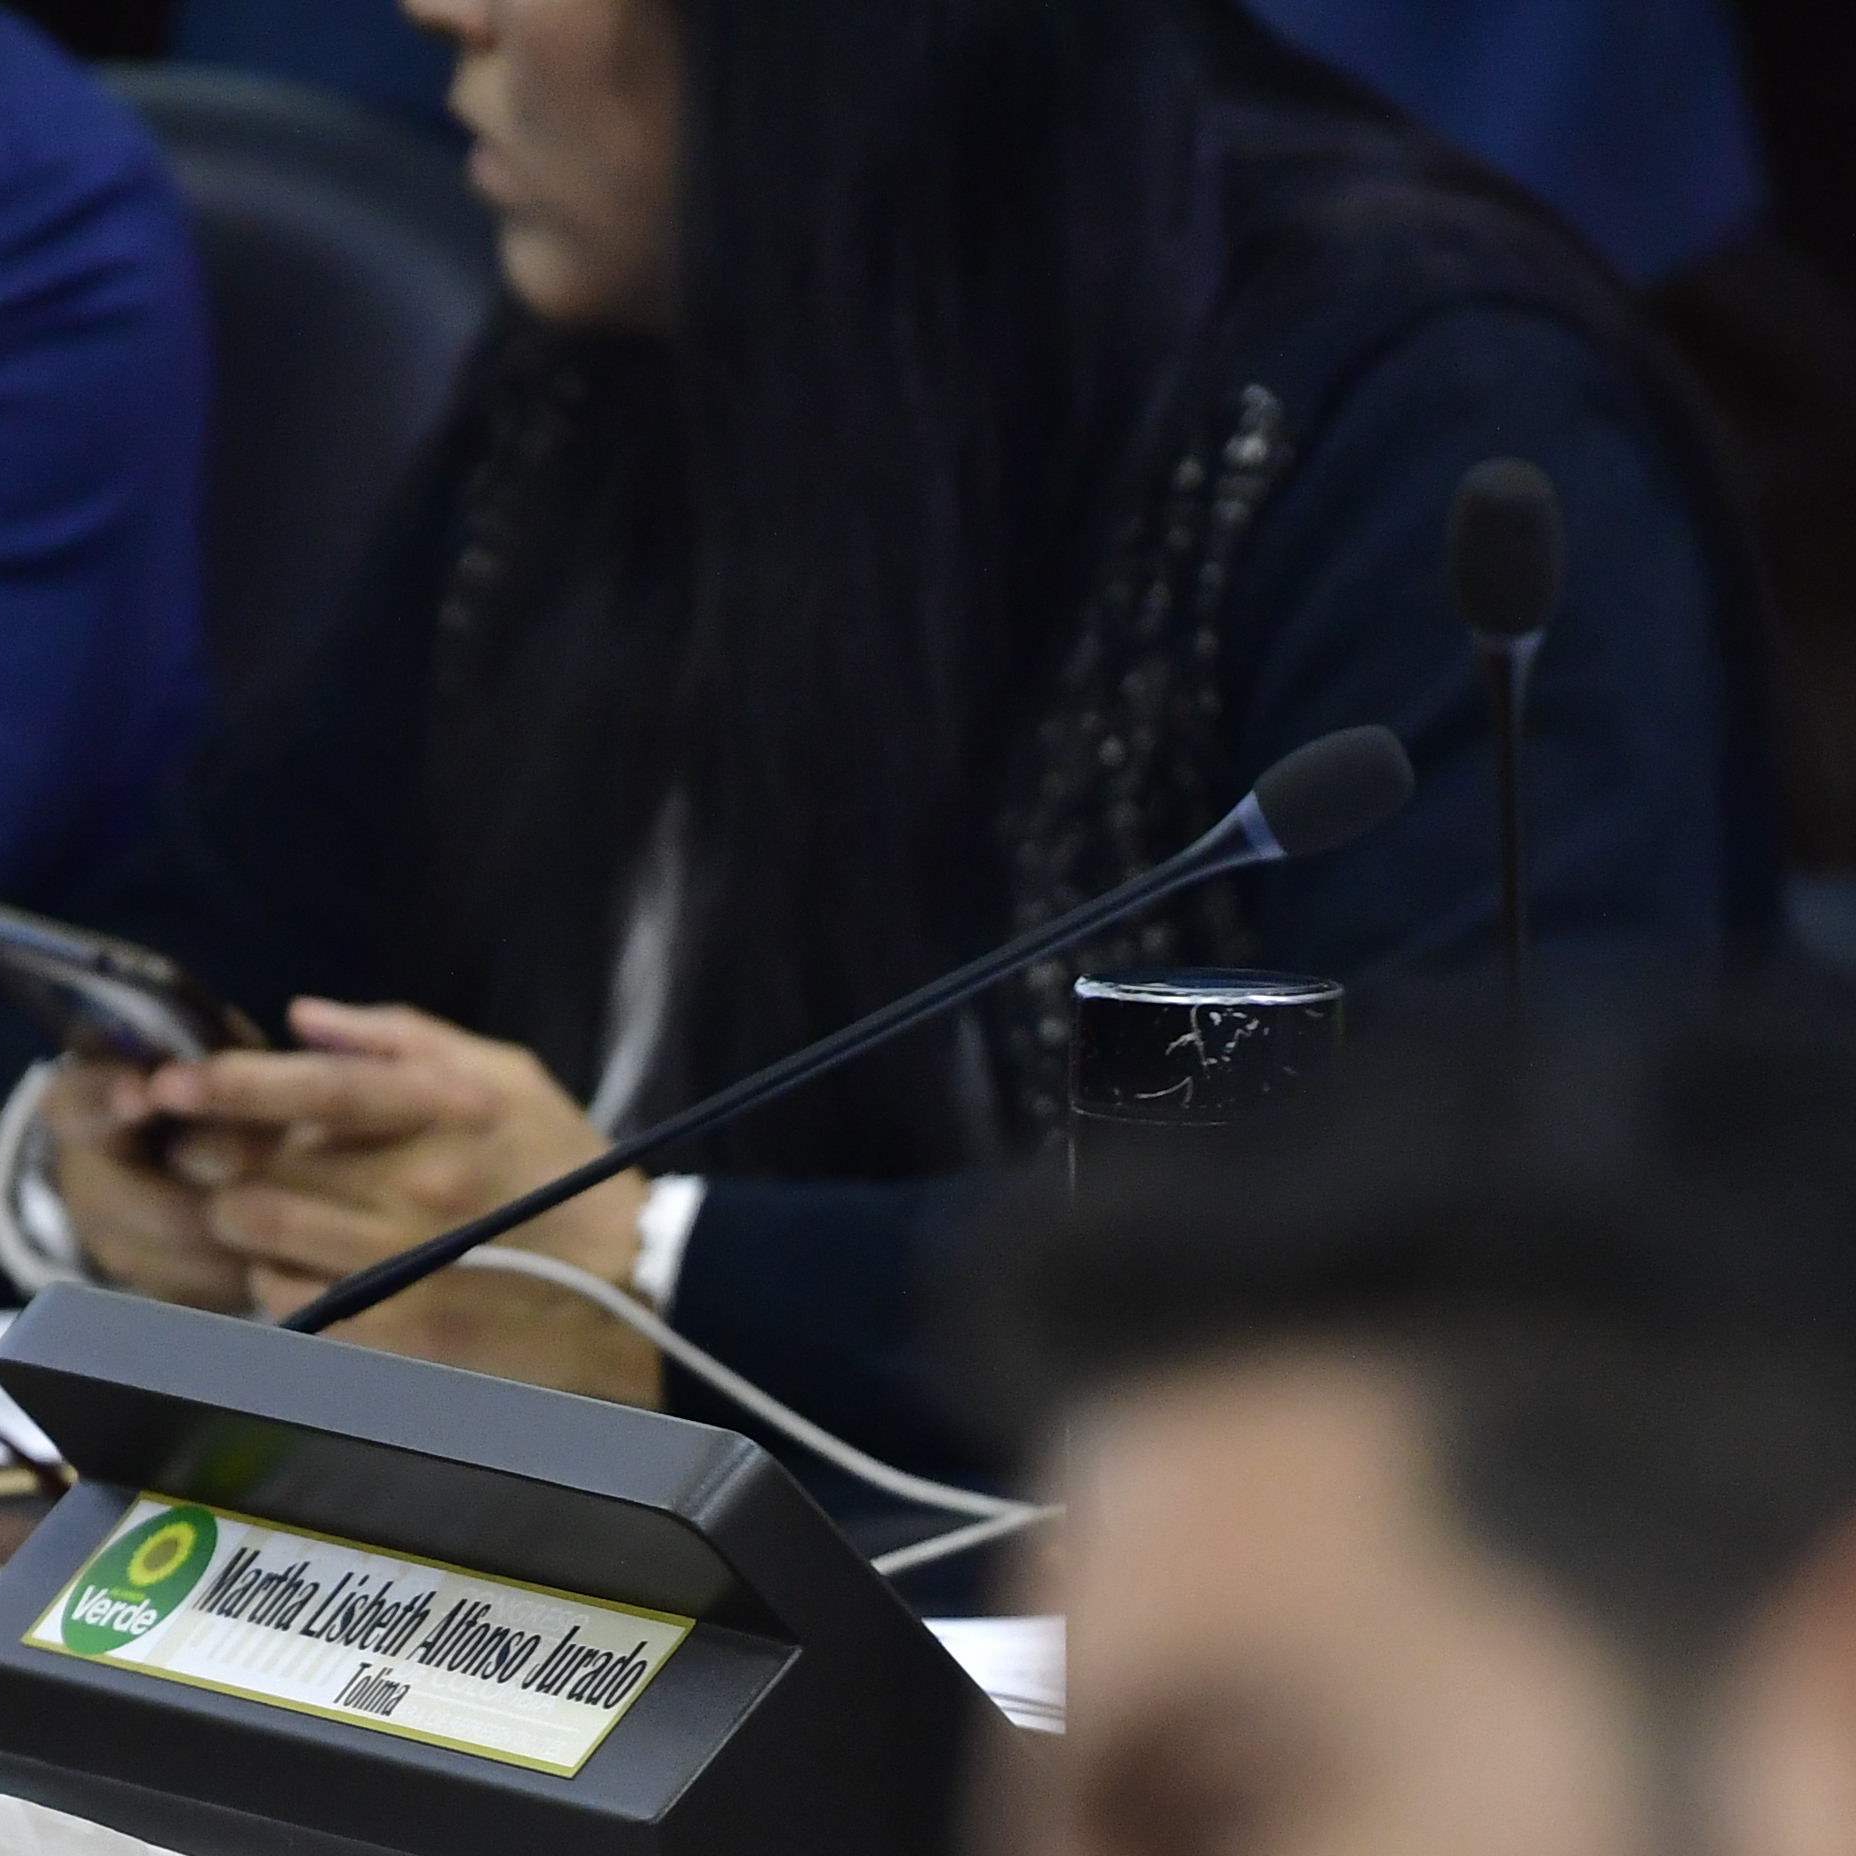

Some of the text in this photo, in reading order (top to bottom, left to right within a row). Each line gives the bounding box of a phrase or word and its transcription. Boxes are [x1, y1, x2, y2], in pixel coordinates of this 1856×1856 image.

[71, 1585, 158, 1635] Verde
[192, 1547, 648, 1709] Martha Lisbeth Alfonso Jurado
[333, 1661, 411, 1717] Tolima
